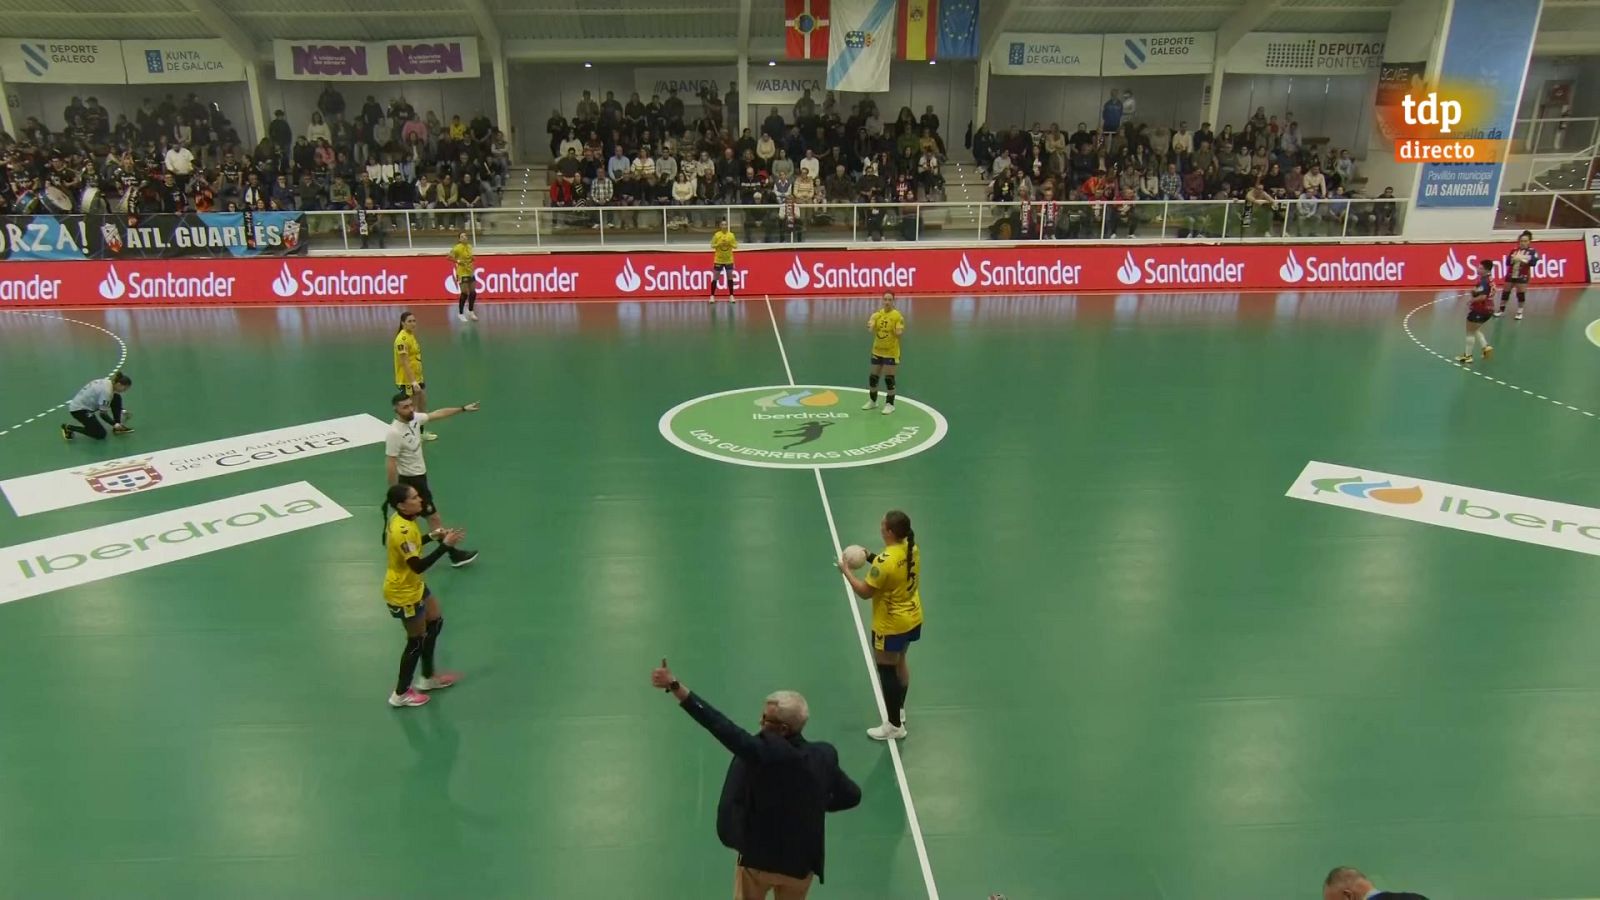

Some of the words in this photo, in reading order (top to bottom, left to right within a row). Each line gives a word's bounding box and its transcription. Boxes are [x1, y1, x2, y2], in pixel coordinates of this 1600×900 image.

[50, 45, 98, 54] DEPORTE
[1028, 45, 1061, 54] XUNTA
[1151, 37, 1195, 46] DEPORTE
[1151, 47, 1189, 56] GALEGO
[52, 54, 95, 64] GALEGO
[166, 51, 200, 60] XUNTA
[167, 62, 180, 71] DE
[183, 61, 224, 71] GALICIA
[291, 45, 368, 76] NON
[387, 43, 464, 75] NON
[1027, 55, 1039, 64] DE
[1041, 55, 1080, 64] GALICIA
[1425, 184, 1438, 196] DA
[1440, 181, 1489, 196] SANGRIÑA
[1457, 170, 1493, 182] municipal
[127, 226, 172, 250] ATL.
[301, 268, 408, 297] Santander
[474, 267, 579, 293] Santander
[813, 261, 916, 289] Santander
[980, 259, 1082, 287] Santander
[1144, 257, 1244, 284] Santander
[1306, 256, 1405, 283] Santander
[128, 270, 236, 299] Santander
[752, 412, 849, 421] Iberdrola
[169, 449, 236, 467] Ciudad
[245, 429, 337, 451] Autónoma
[175, 463, 201, 472] de
[216, 436, 350, 467] Ceuta
[690, 429, 720, 445] LIGA
[716, 442, 841, 460] GUERRERAS
[843, 425, 920, 458] IBERDROLA
[16, 498, 323, 580] Iberdrola
